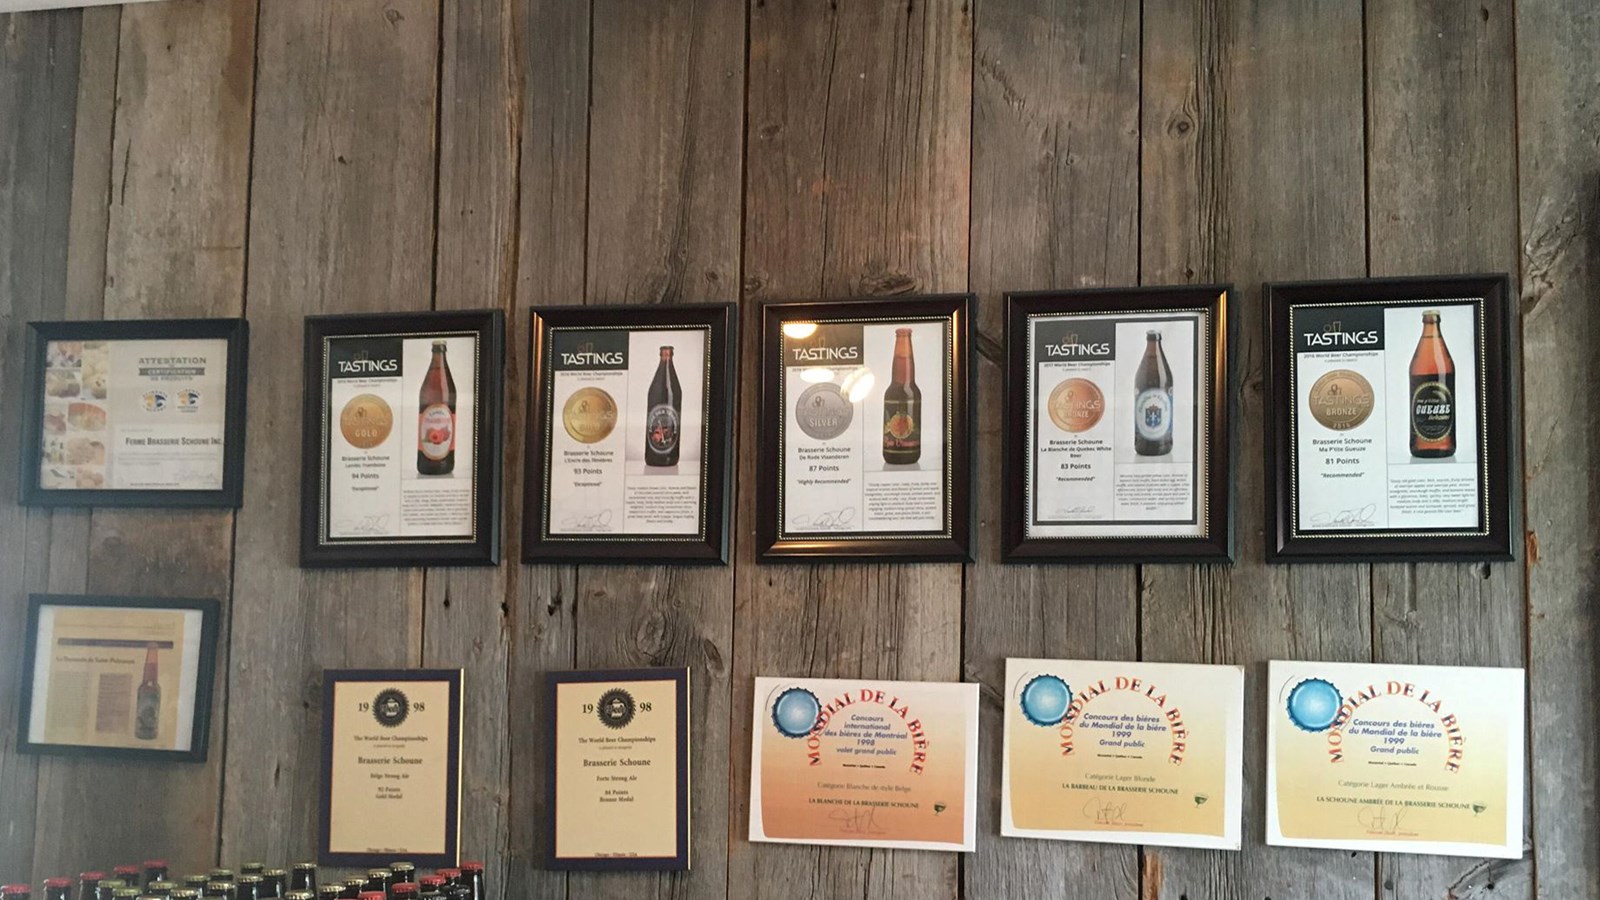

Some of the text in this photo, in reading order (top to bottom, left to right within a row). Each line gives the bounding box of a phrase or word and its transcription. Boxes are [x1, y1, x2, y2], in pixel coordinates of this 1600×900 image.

[1304, 331, 1378, 346] TASTINGS
[792, 347, 858, 360] TASTINGS
[1045, 344, 1109, 356] TASTINGS
[561, 353, 623, 365] TASTINGS
[338, 360, 397, 372] TASTINGS
[1327, 408, 1356, 416] BRONZE
[810, 418, 837, 427] SILVER
[359, 702, 425, 712] 19 98
[583, 702, 651, 713] 19 98
[851, 714, 883, 722] Concours
[1115, 676, 1142, 692] DE
[1145, 684, 1168, 708] LA
[1165, 708, 1189, 766] BIÈRE
[1353, 718, 1390, 727] Concours
[844, 722, 891, 730] international
[1386, 681, 1415, 697] DE
[1419, 689, 1441, 713] LA
[1441, 713, 1467, 774] BIÈRE
[860, 689, 885, 704] DE
[888, 696, 909, 719] LA
[907, 719, 929, 775] BIÈRE
[1362, 727, 1395, 735] Mondial
[1410, 729, 1418, 737] la
[1370, 746, 1419, 755] Grand public
[584, 758, 651, 767] Brasserie Schoune
[1116, 774, 1132, 782] Lager
[1371, 781, 1388, 789] Lager
